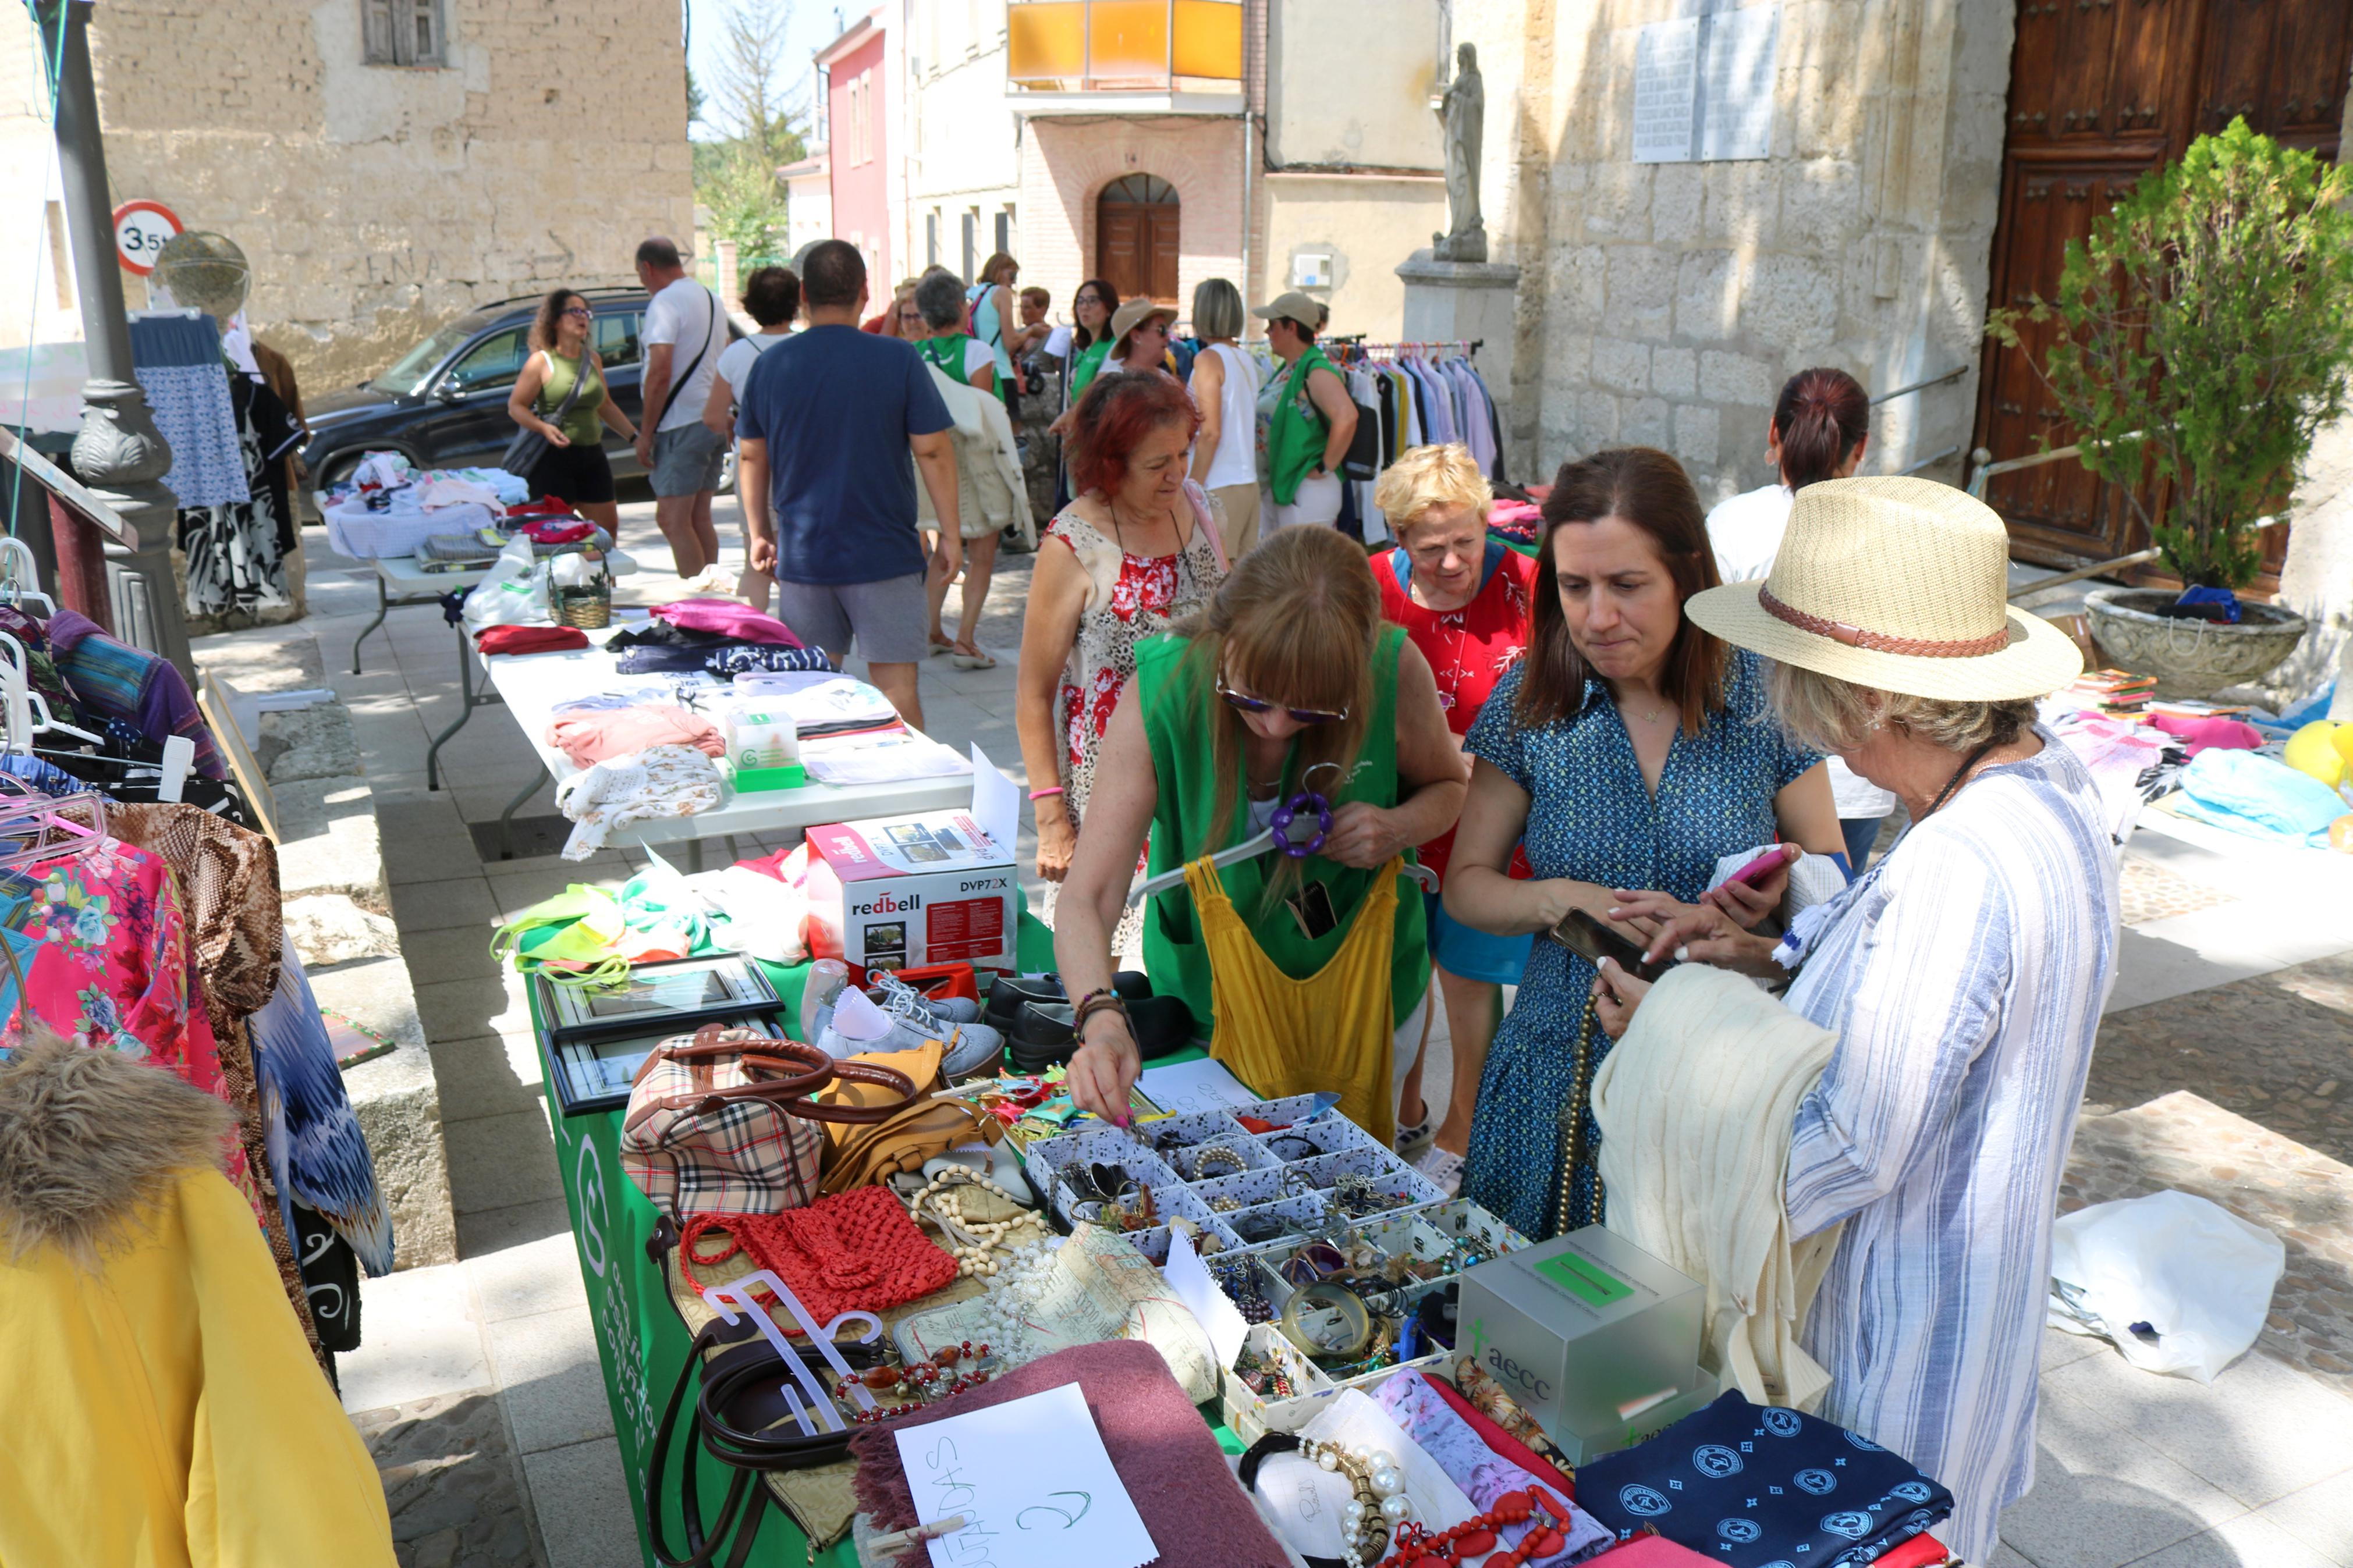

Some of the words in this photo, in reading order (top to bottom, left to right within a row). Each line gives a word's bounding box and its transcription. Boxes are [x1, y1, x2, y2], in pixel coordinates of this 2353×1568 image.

[831, 836, 868, 863] redbell
[961, 878, 1007, 891] DVP72X
[853, 893, 920, 915] redbell
[1489, 1348, 1550, 1400] aecc
